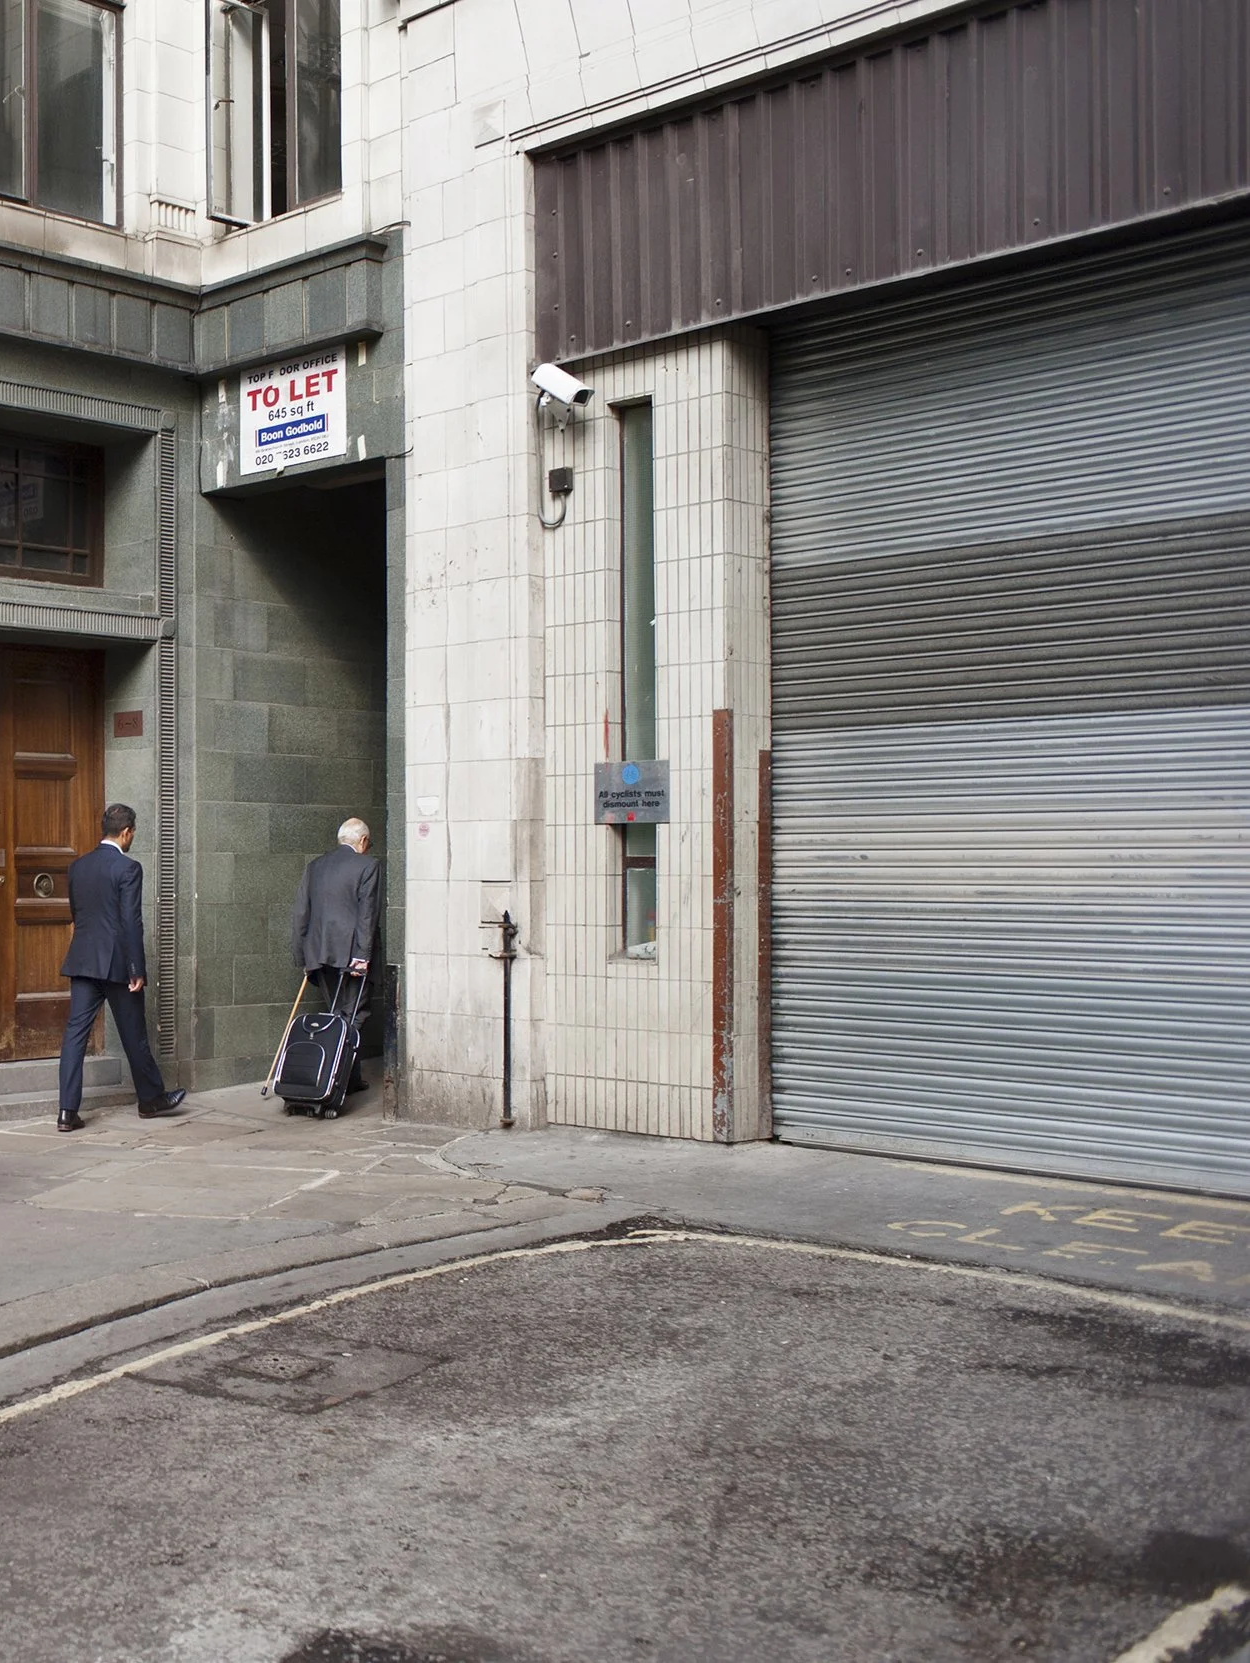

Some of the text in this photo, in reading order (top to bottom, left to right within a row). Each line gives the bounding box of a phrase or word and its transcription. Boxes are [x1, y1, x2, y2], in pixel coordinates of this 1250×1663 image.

[247, 353, 338, 384] TOP FOOR OFFICE
[247, 368, 338, 412] TO LET
[268, 401, 314, 421] 645 sq ft
[261, 419, 323, 443] Boon Godbold
[255, 453, 274, 466] 020
[303, 441, 329, 455] 6622
[602, 800, 661, 809] dismount here
[611, 789, 642, 800] cyclists
[644, 789, 665, 797] must
[886, 1219, 1250, 1286] CLEA
